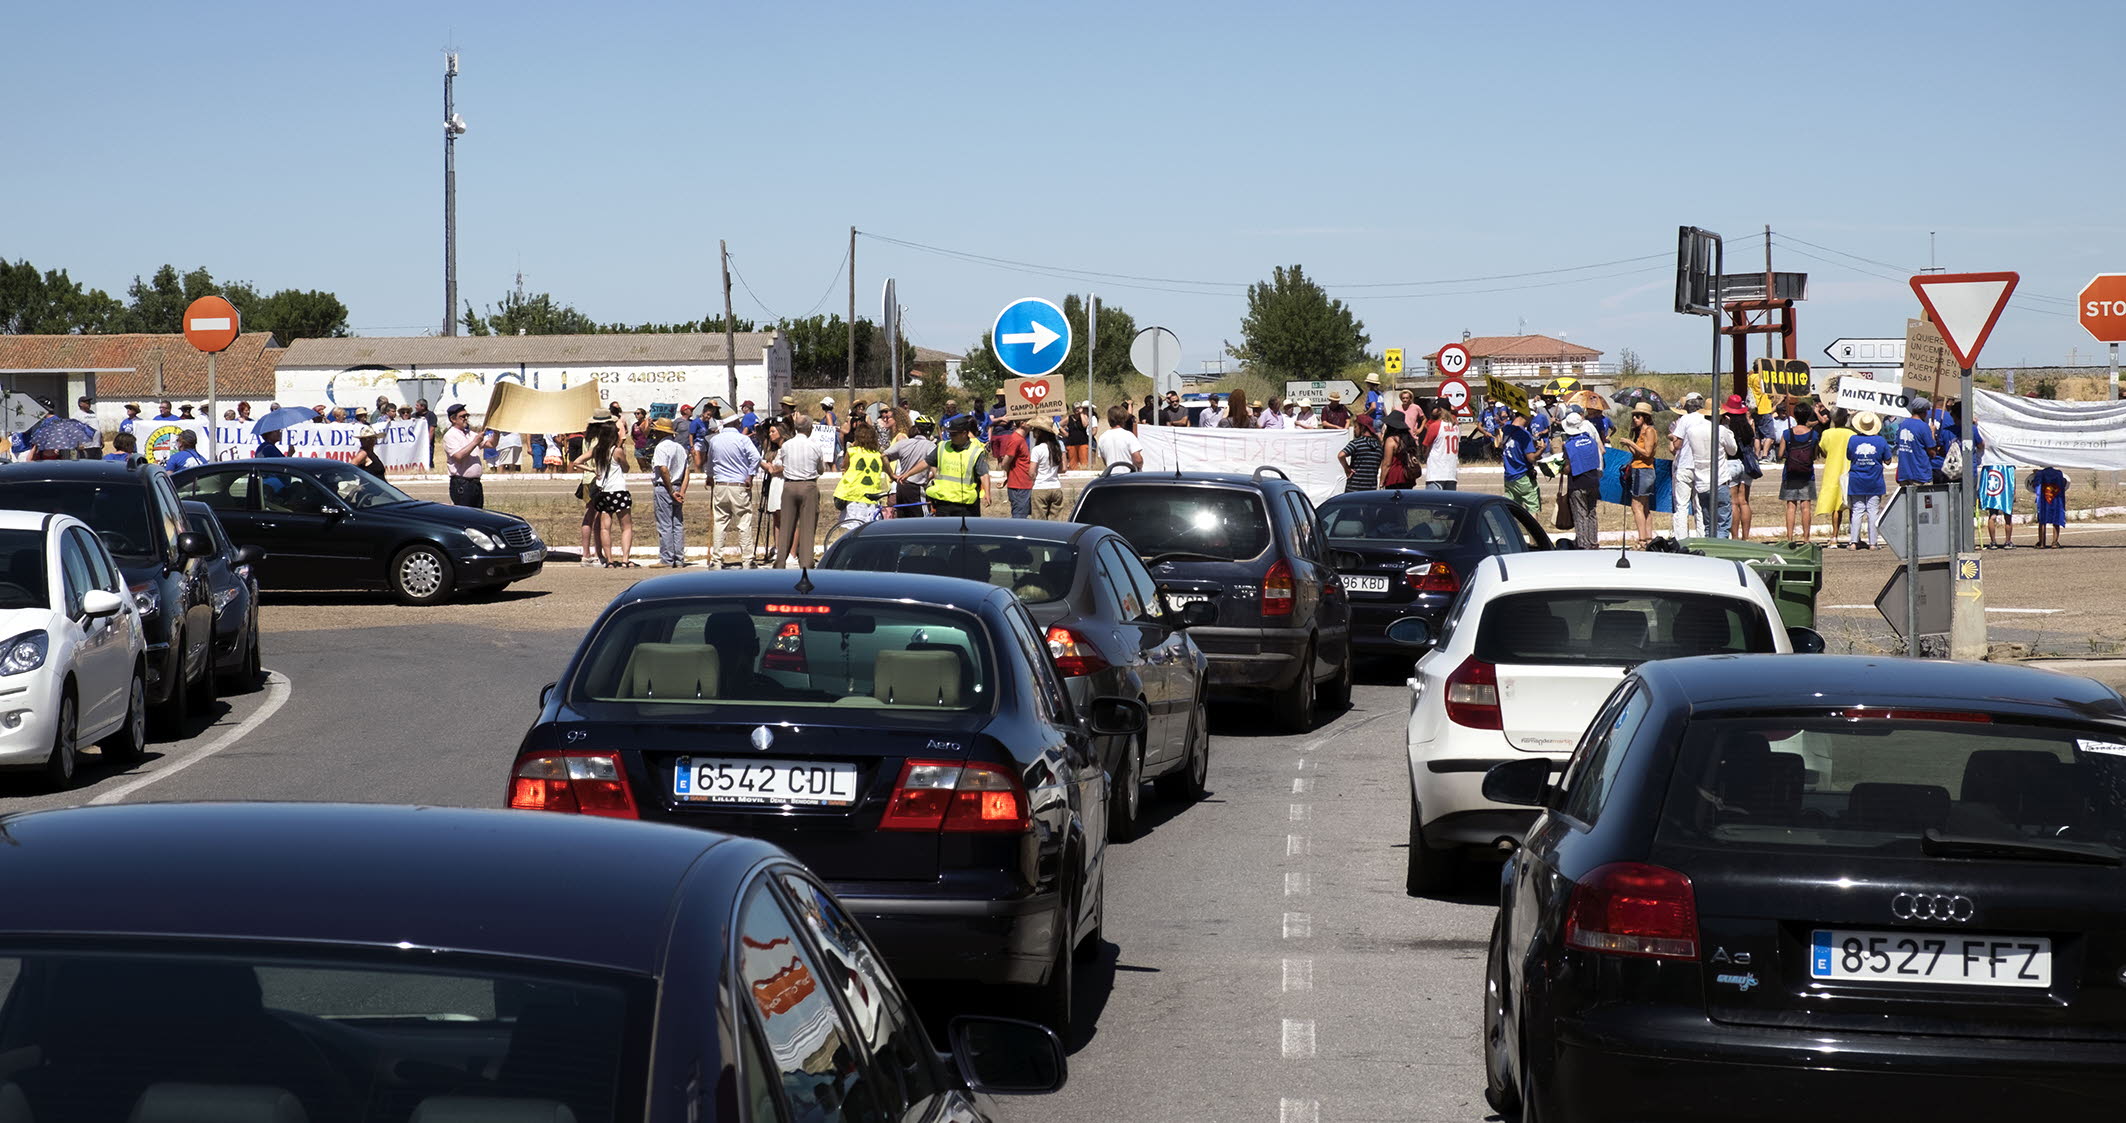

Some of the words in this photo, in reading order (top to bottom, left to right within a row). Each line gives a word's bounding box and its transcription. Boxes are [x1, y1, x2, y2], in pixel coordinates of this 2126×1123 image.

[2086, 301, 2126, 317] STO
[1910, 342, 1922, 351] UN
[1923, 345, 1954, 357] CEMEN
[1445, 355, 1463, 366] 70
[1909, 353, 1945, 365] NUCLEAR
[1946, 359, 1958, 368] EN
[1907, 371, 1932, 383] CASA?
[1939, 368, 1951, 377] DE
[1024, 385, 1046, 398] YO
[1842, 388, 1875, 402] MINA
[1880, 393, 1909, 408] NO
[1010, 403, 1034, 412] CAMPO
[1035, 399, 1063, 410] CHARRO
[331, 428, 356, 447] DE
[1445, 435, 1459, 455] 10
[1343, 577, 1358, 589] 96
[1361, 577, 1385, 590] KBD
[567, 730, 587, 744] 95
[926, 739, 961, 751] Aero
[680, 780, 688, 789] E
[697, 763, 776, 793] 6542
[788, 766, 846, 796] CDL
[738, 796, 765, 804] MOVIL
[1710, 946, 1751, 965] A3
[1841, 936, 1946, 976] 8527
[1962, 940, 2040, 981] FFZ
[1818, 958, 1827, 970] E
